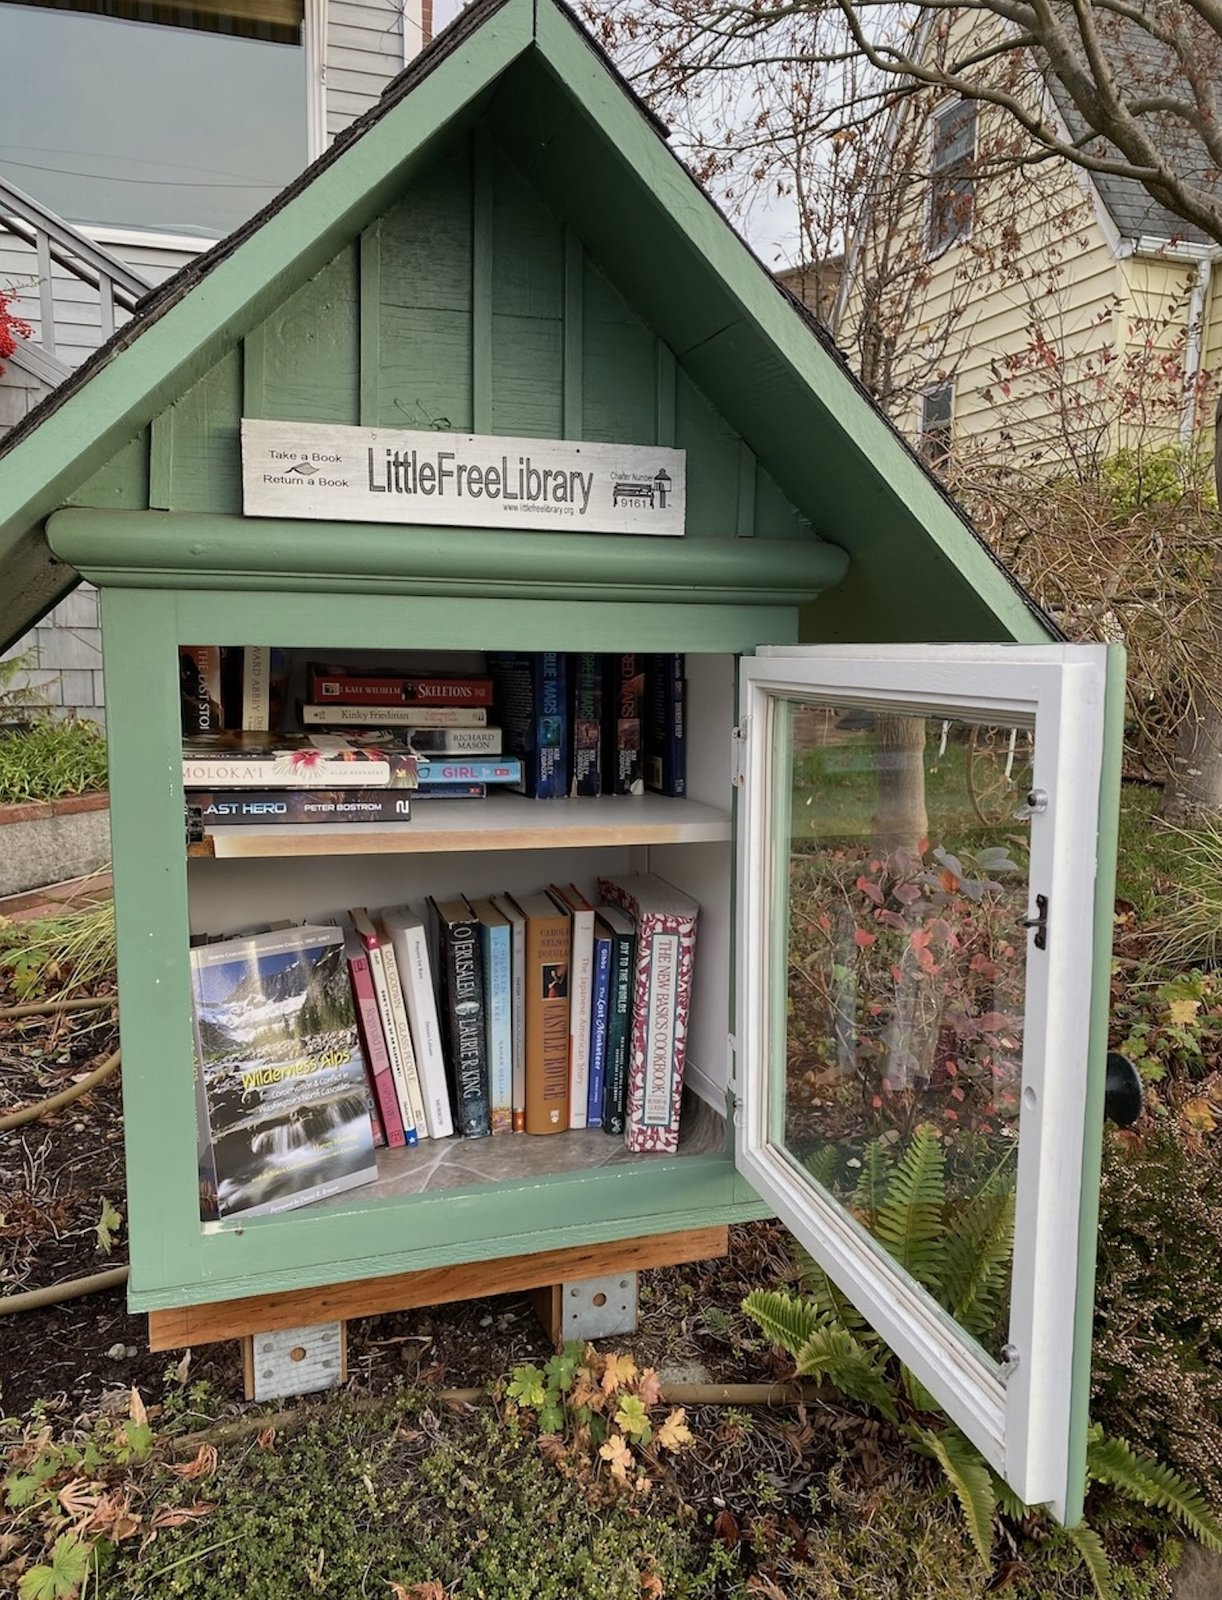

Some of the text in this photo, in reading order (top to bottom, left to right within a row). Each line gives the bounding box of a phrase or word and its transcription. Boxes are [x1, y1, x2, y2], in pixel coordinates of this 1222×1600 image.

[268, 450, 343, 463] Take a Book
[262, 474, 350, 488] Return a Book
[367, 446, 594, 515] LittleFreeLibrary
[632, 472, 654, 482] Number
[620, 498, 647, 509] 9161
[198, 650, 210, 671] THE
[198, 673, 210, 700] LAST
[251, 679, 262, 712] ABBEY
[366, 686, 401, 696] WILHELM
[417, 683, 473, 699] SKELETONS
[543, 653, 557, 715] BLUE MARS
[580, 653, 595, 720] GREEN MARS
[621, 680, 635, 719] MARS
[341, 711, 409, 723] Kinky Friedman
[453, 732, 495, 743] RICHARD
[456, 741, 490, 750] MASON
[441, 767, 480, 779] GIRL
[203, 802, 288, 815] AST HERO
[303, 803, 382, 812] PETER BOSTROM
[450, 926, 476, 1000] O JERUSALEM
[384, 950, 402, 1010] GAIL GODWIN
[616, 941, 630, 1014] JOY TO THE WORLDS
[380, 989, 389, 1008] DON'T
[594, 948, 608, 1070] Gibbs The Last Musketeer
[574, 958, 591, 1087] The Japanese American Story
[651, 939, 673, 1095] THE NEW BASICS COOKBOOK
[365, 1007, 386, 1062] Reginald Hill
[388, 1027, 394, 1036] OF
[390, 1036, 396, 1046] AN
[458, 1017, 479, 1058] LAURIE
[397, 1022, 416, 1084] GLASS PEOPLE
[542, 1003, 569, 1101] CASTLE ROUGE
[242, 1050, 351, 1089] Wilderness Alps
[319, 1074, 343, 1086] Conflict
[462, 1068, 481, 1099] KING
